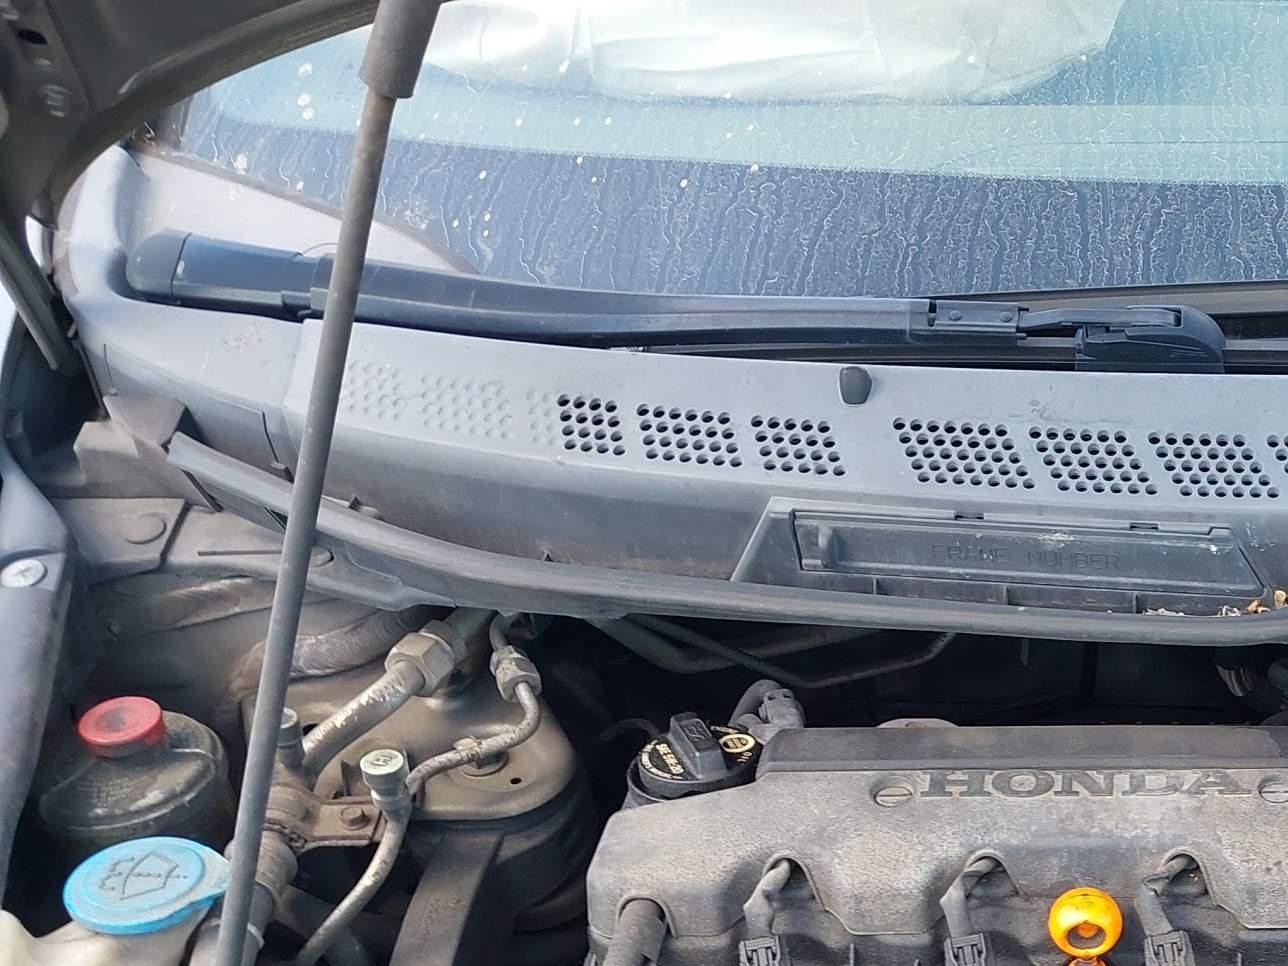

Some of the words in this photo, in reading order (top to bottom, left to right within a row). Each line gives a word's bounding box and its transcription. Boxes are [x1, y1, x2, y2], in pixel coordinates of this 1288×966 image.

[931, 544, 1009, 563] FRAME
[1027, 551, 1120, 570] NUMBER
[919, 769, 1253, 799] HONDA
